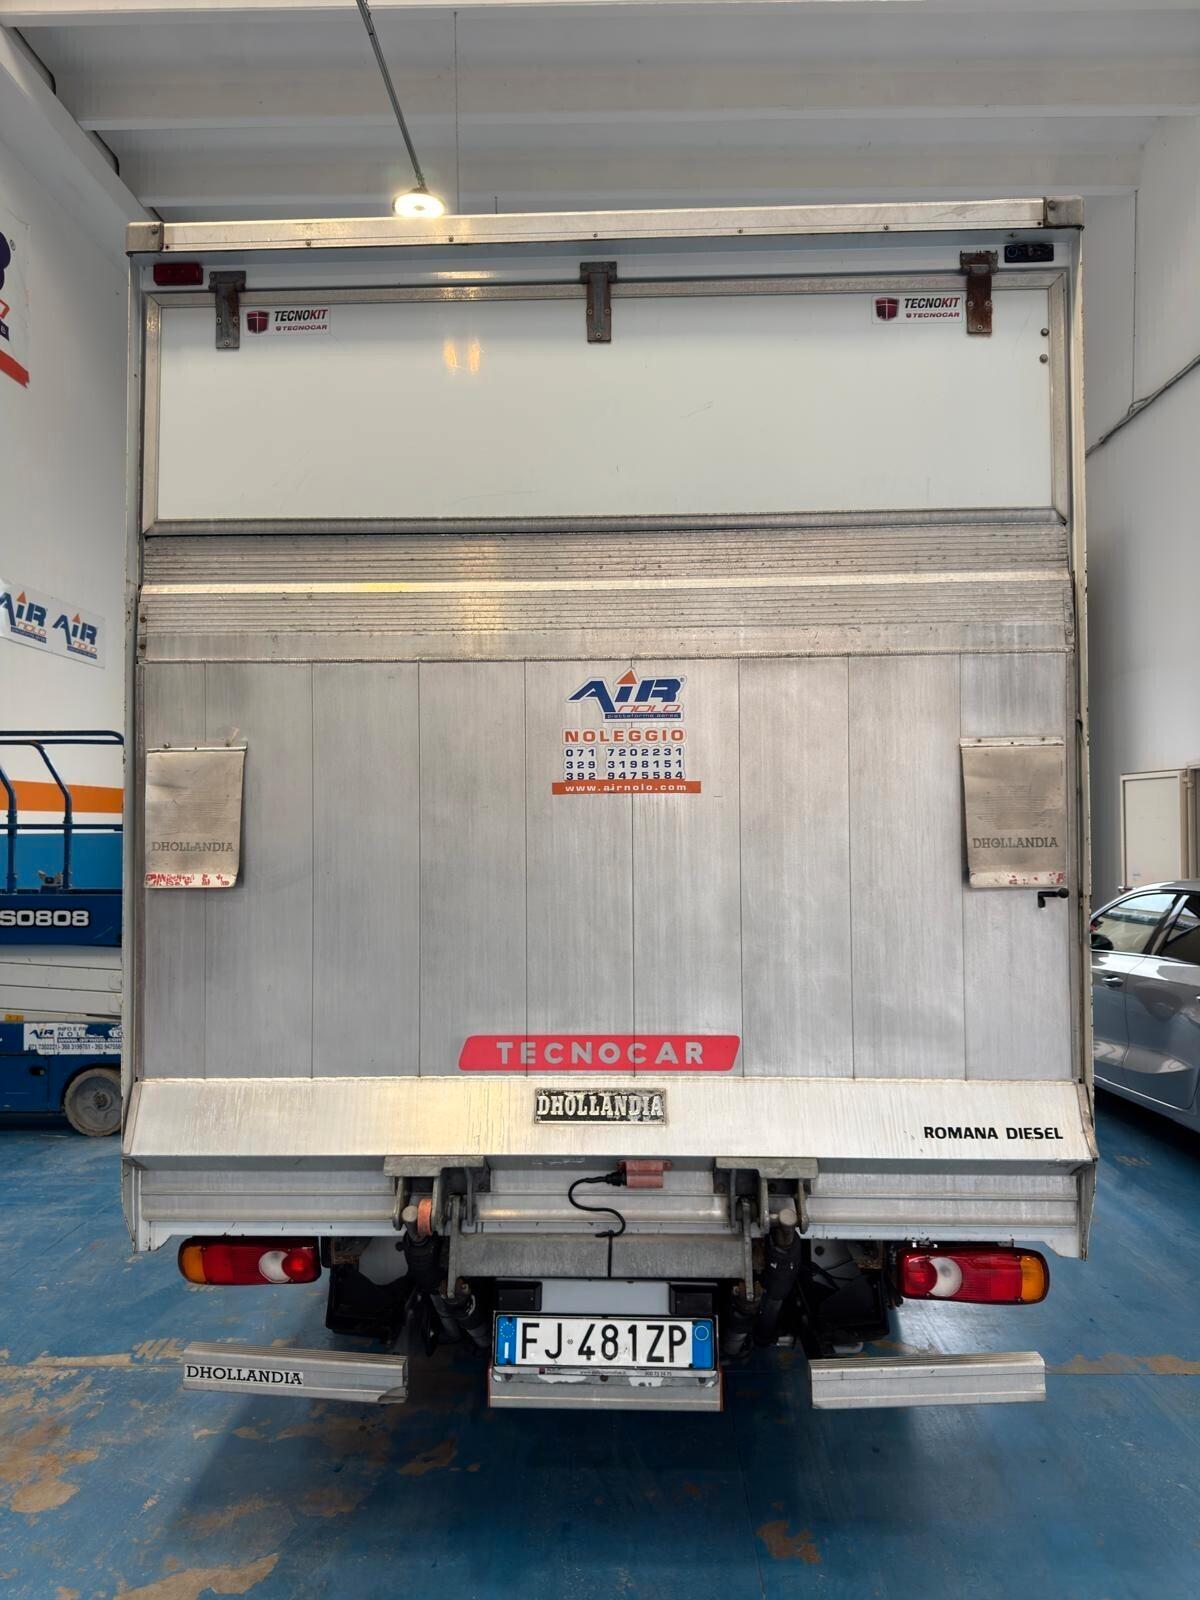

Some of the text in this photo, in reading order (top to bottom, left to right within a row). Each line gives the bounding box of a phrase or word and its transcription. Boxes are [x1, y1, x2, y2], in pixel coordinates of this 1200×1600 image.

[904, 297, 961, 309] TECNOKIT
[274, 309, 328, 322] TECNOKIT
[565, 729, 684, 742] NOLEGGIO
[565, 748, 683, 757] 071 7202231
[565, 760, 683, 769] 329 3198151
[565, 771, 683, 780] 392 9475584
[565, 782, 687, 792] www.airnolo.com
[151, 841, 234, 852] DHOLLANDIA
[972, 837, 1059, 848] DHOLLANDIA
[496, 1041, 704, 1065] TECNOCAR
[537, 1094, 664, 1117] DHOLLANDIA
[923, 1126, 1064, 1140] ROMANA DIESEL
[186, 1365, 303, 1385] DHOLLANDIA
